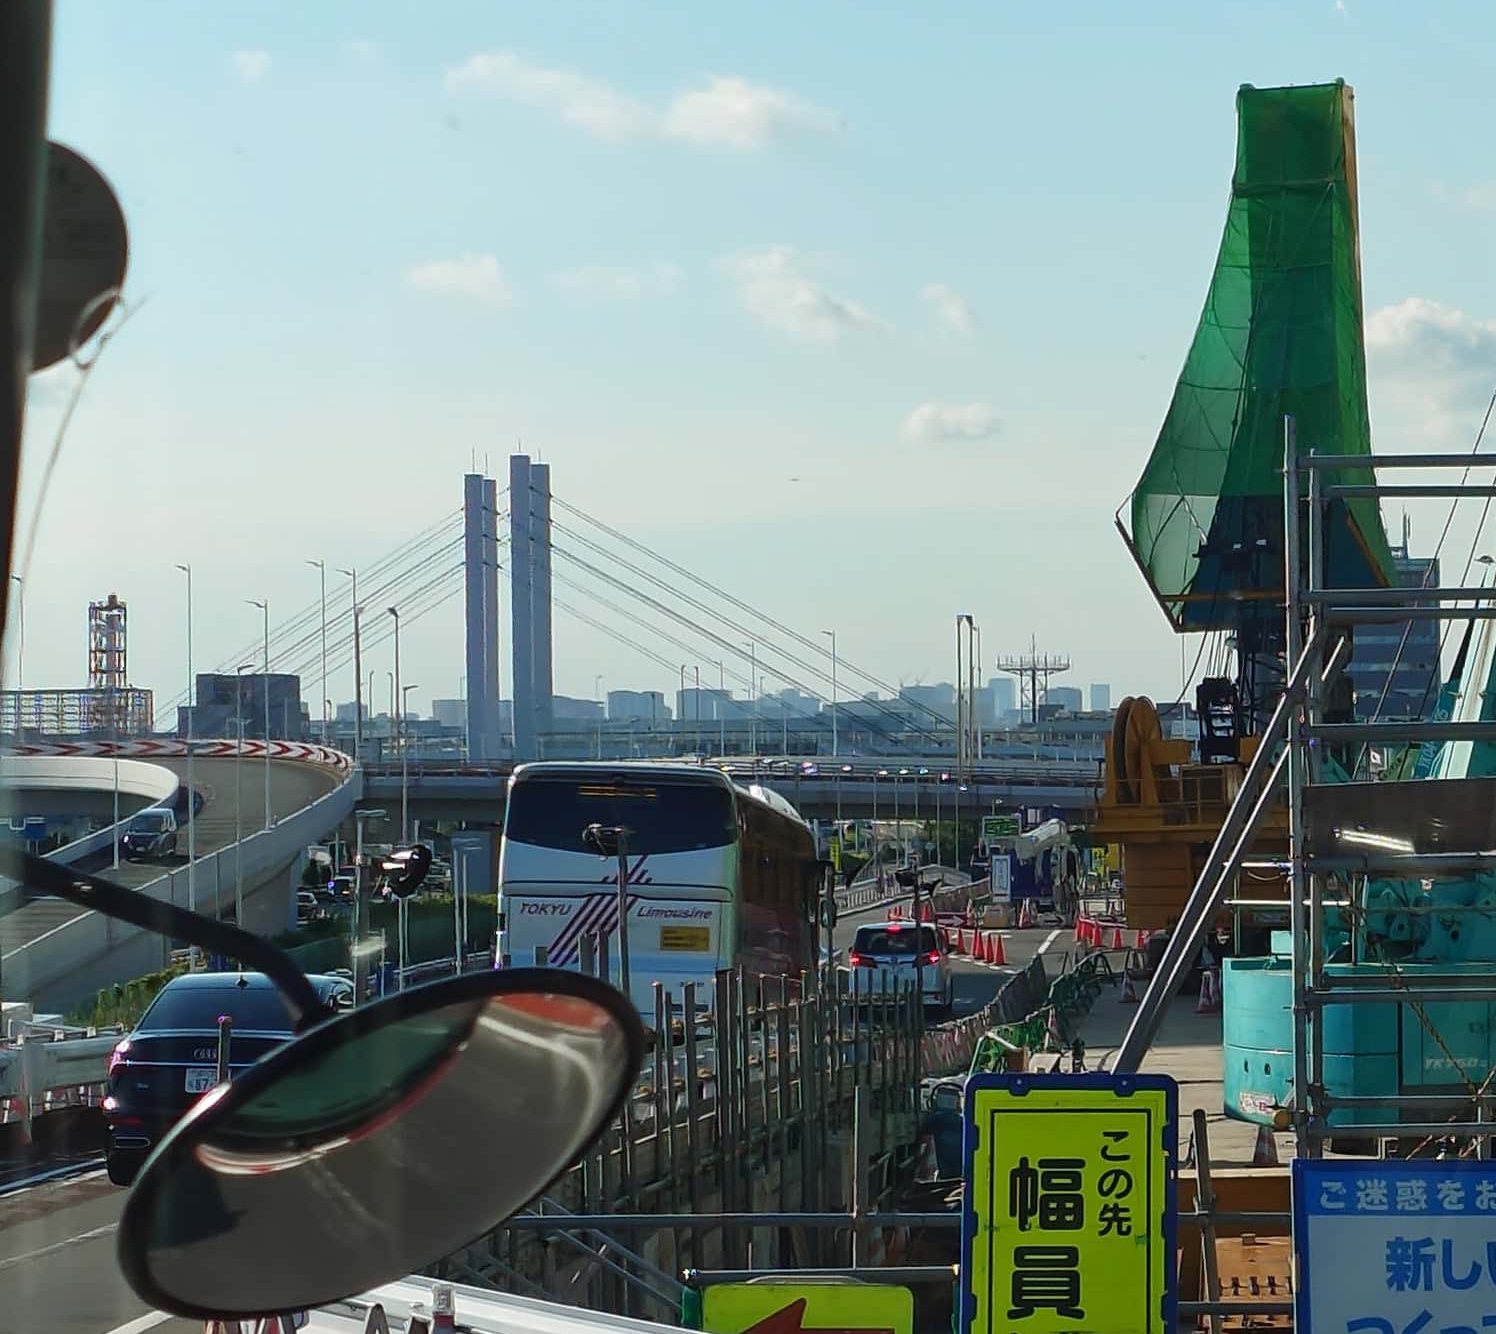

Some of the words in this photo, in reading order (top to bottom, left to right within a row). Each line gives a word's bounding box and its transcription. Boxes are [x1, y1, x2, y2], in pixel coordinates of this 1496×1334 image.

[519, 903, 572, 915] TOKYU
[637, 906, 713, 919] Limousine
[1097, 1129, 1132, 1237] この先
